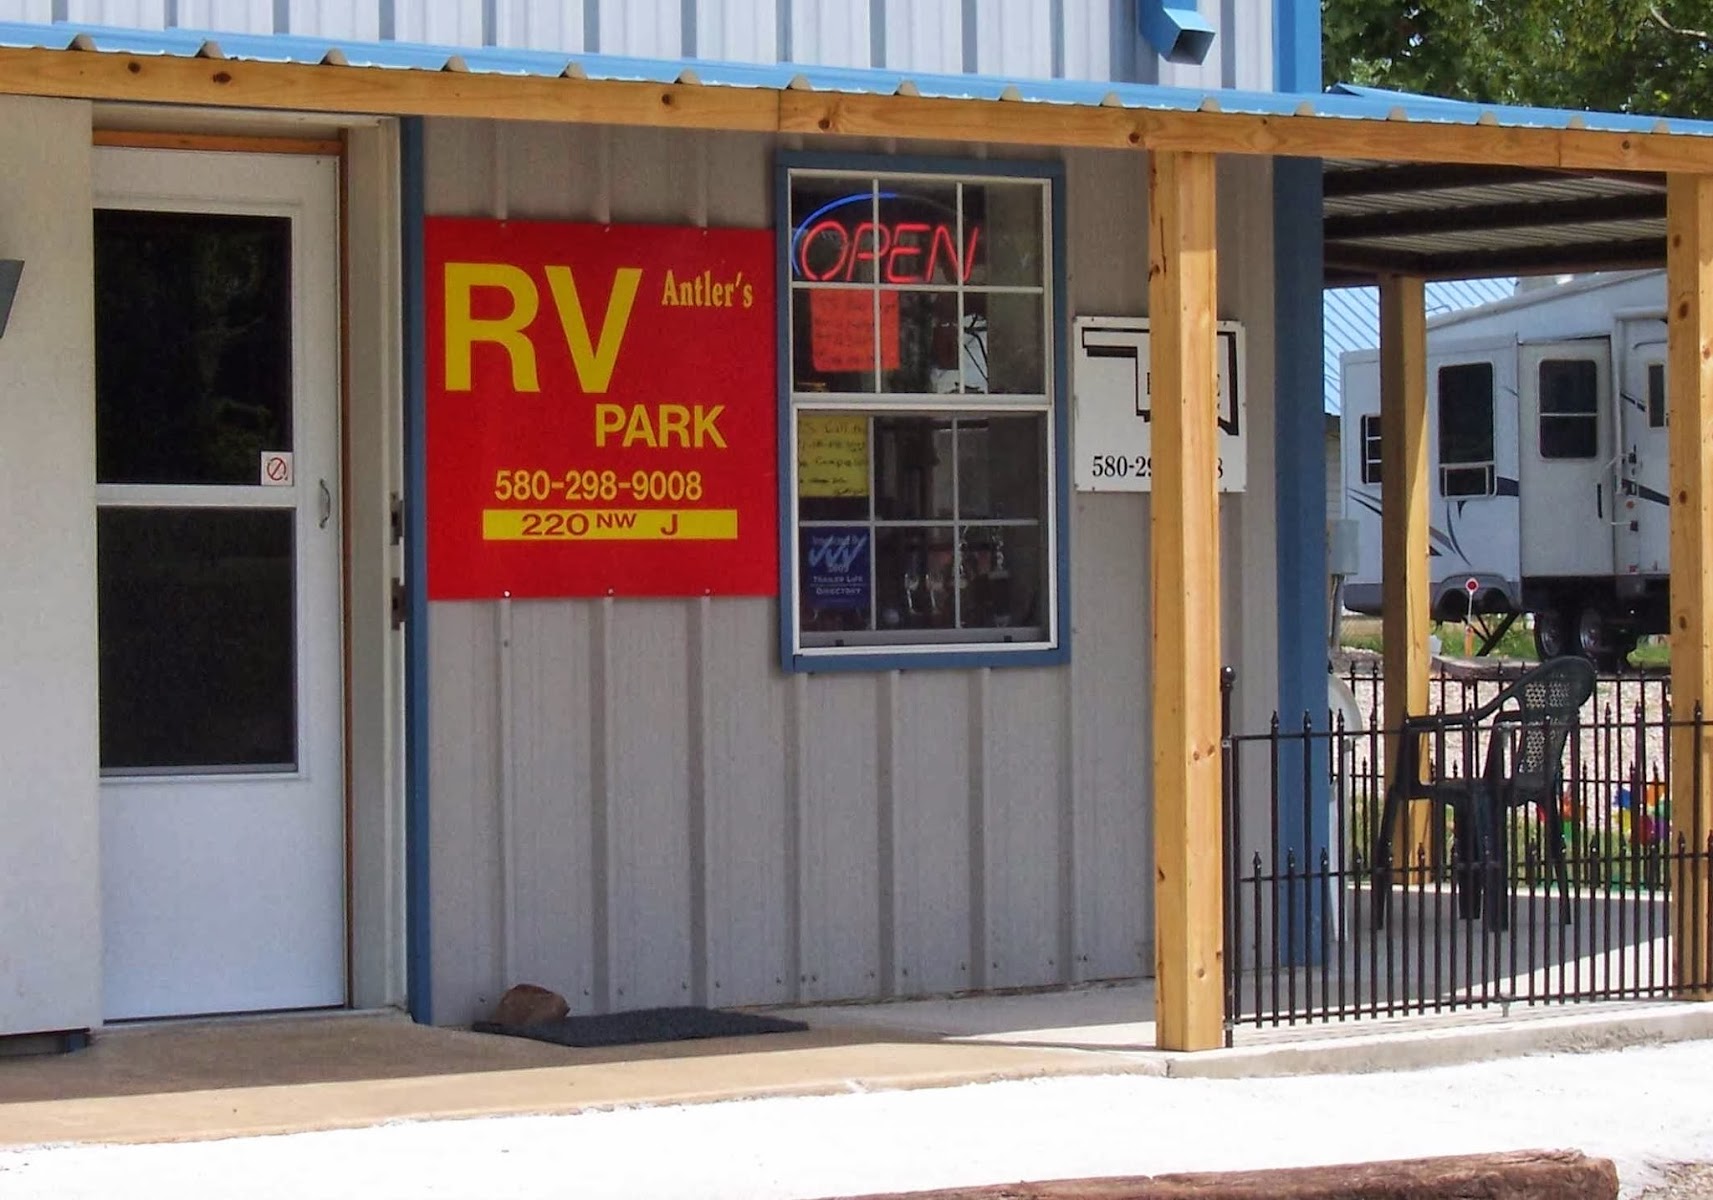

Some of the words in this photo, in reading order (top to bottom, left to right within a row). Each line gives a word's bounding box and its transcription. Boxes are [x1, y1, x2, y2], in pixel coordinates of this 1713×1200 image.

[801, 221, 980, 283] OPEN
[661, 268, 753, 308] Antler's
[444, 262, 643, 393] RV
[595, 403, 728, 448] PARK
[495, 470, 703, 501] 580-298-9008
[521, 513, 589, 536] 220
[596, 513, 637, 528] NW
[660, 514, 679, 536] J
